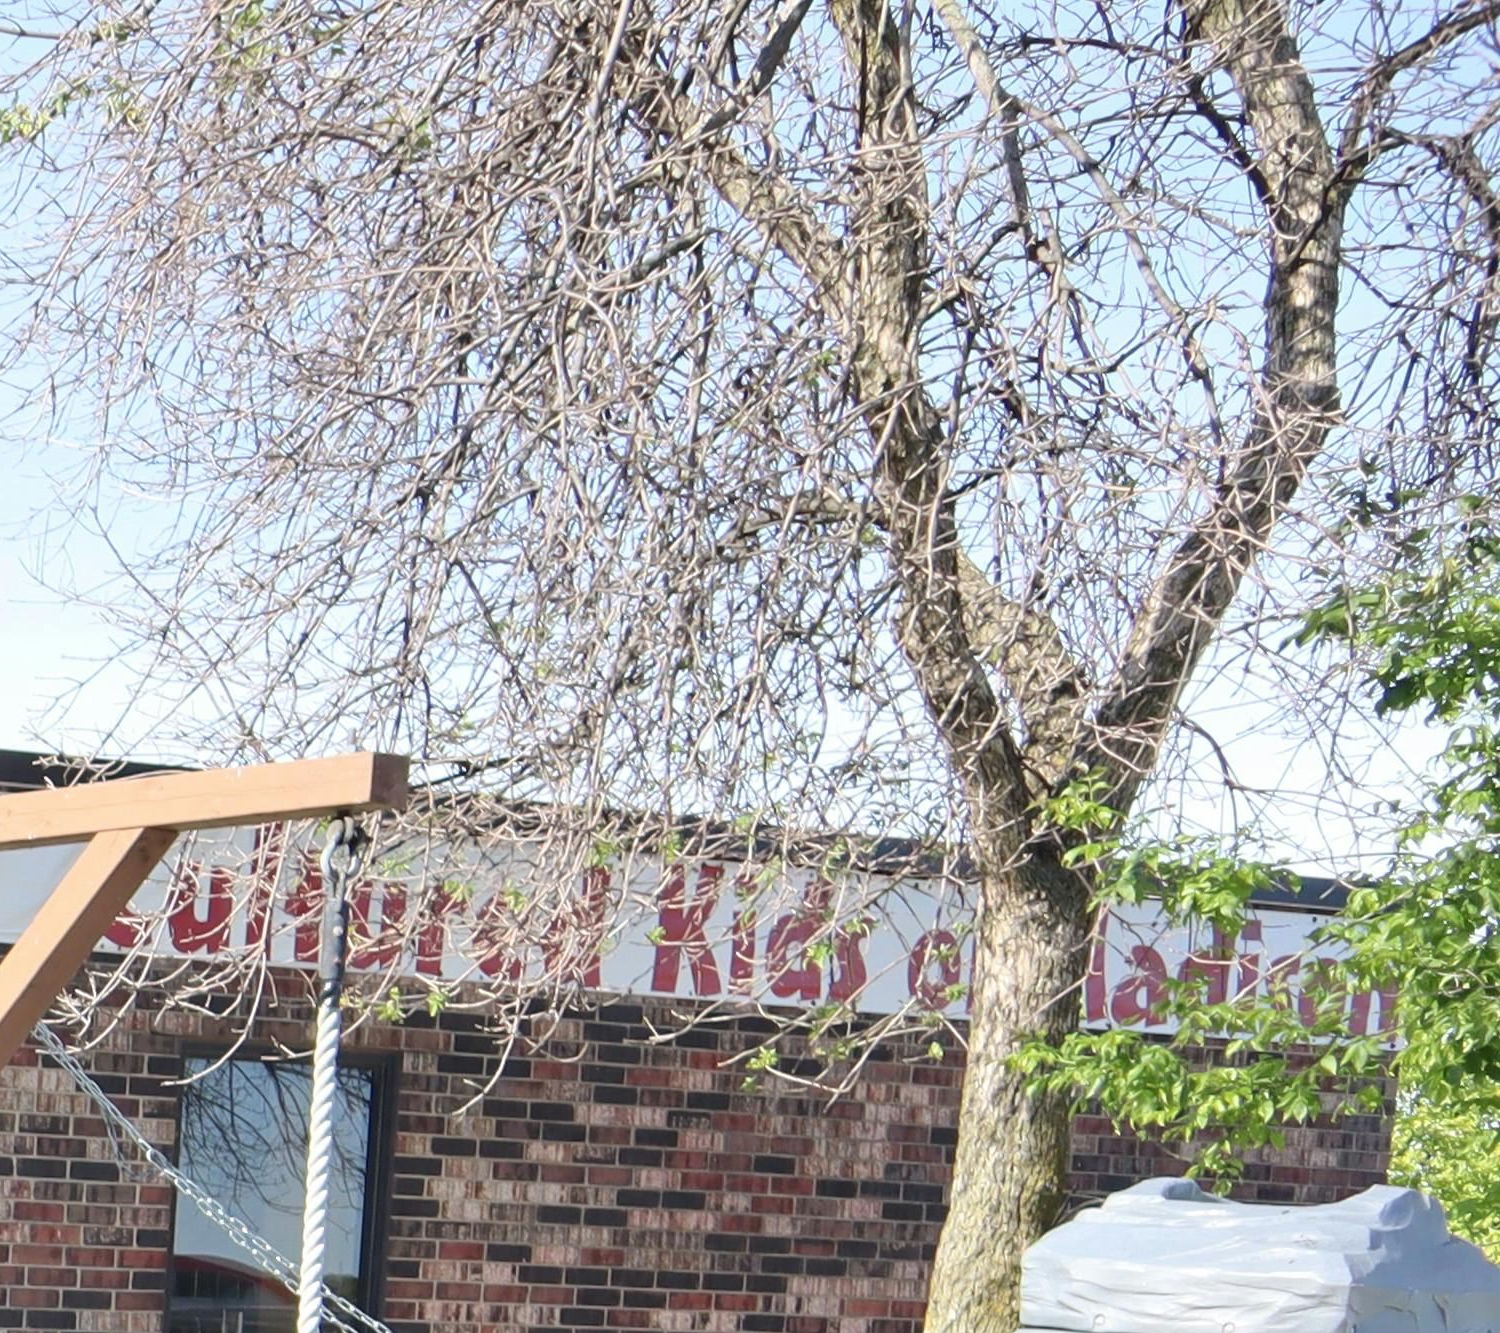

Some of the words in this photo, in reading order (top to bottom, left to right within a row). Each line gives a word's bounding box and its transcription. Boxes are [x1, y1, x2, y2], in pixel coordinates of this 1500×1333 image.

[103, 820, 610, 988] ultural
[652, 864, 873, 1002] Kids
[908, 929, 977, 1014] o
